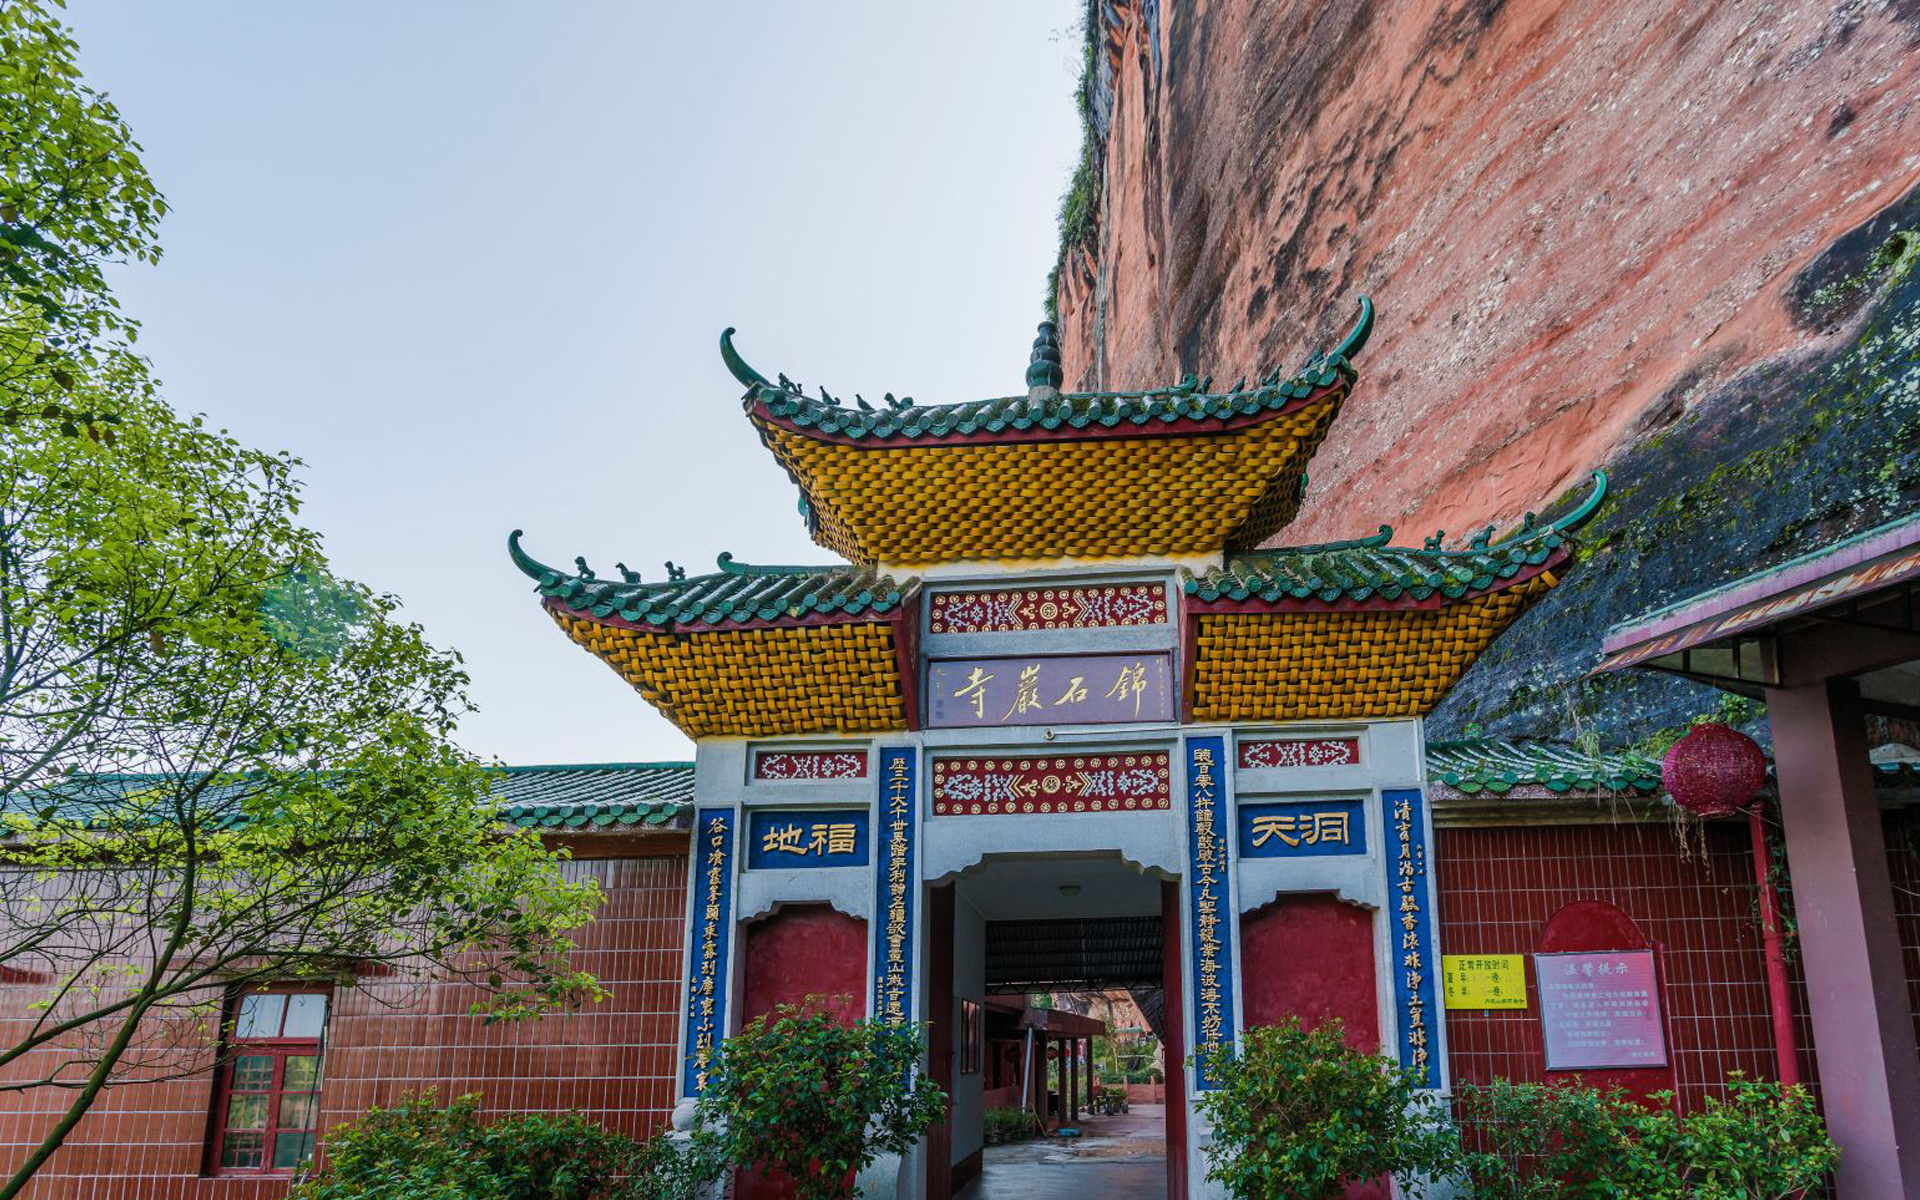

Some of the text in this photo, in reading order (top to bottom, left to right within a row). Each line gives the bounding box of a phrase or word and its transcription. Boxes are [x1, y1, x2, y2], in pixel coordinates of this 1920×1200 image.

[762, 822, 857, 857] 福地
[1251, 811, 1349, 848] 洞天
[1458, 959, 1509, 971] 正常开放时间
